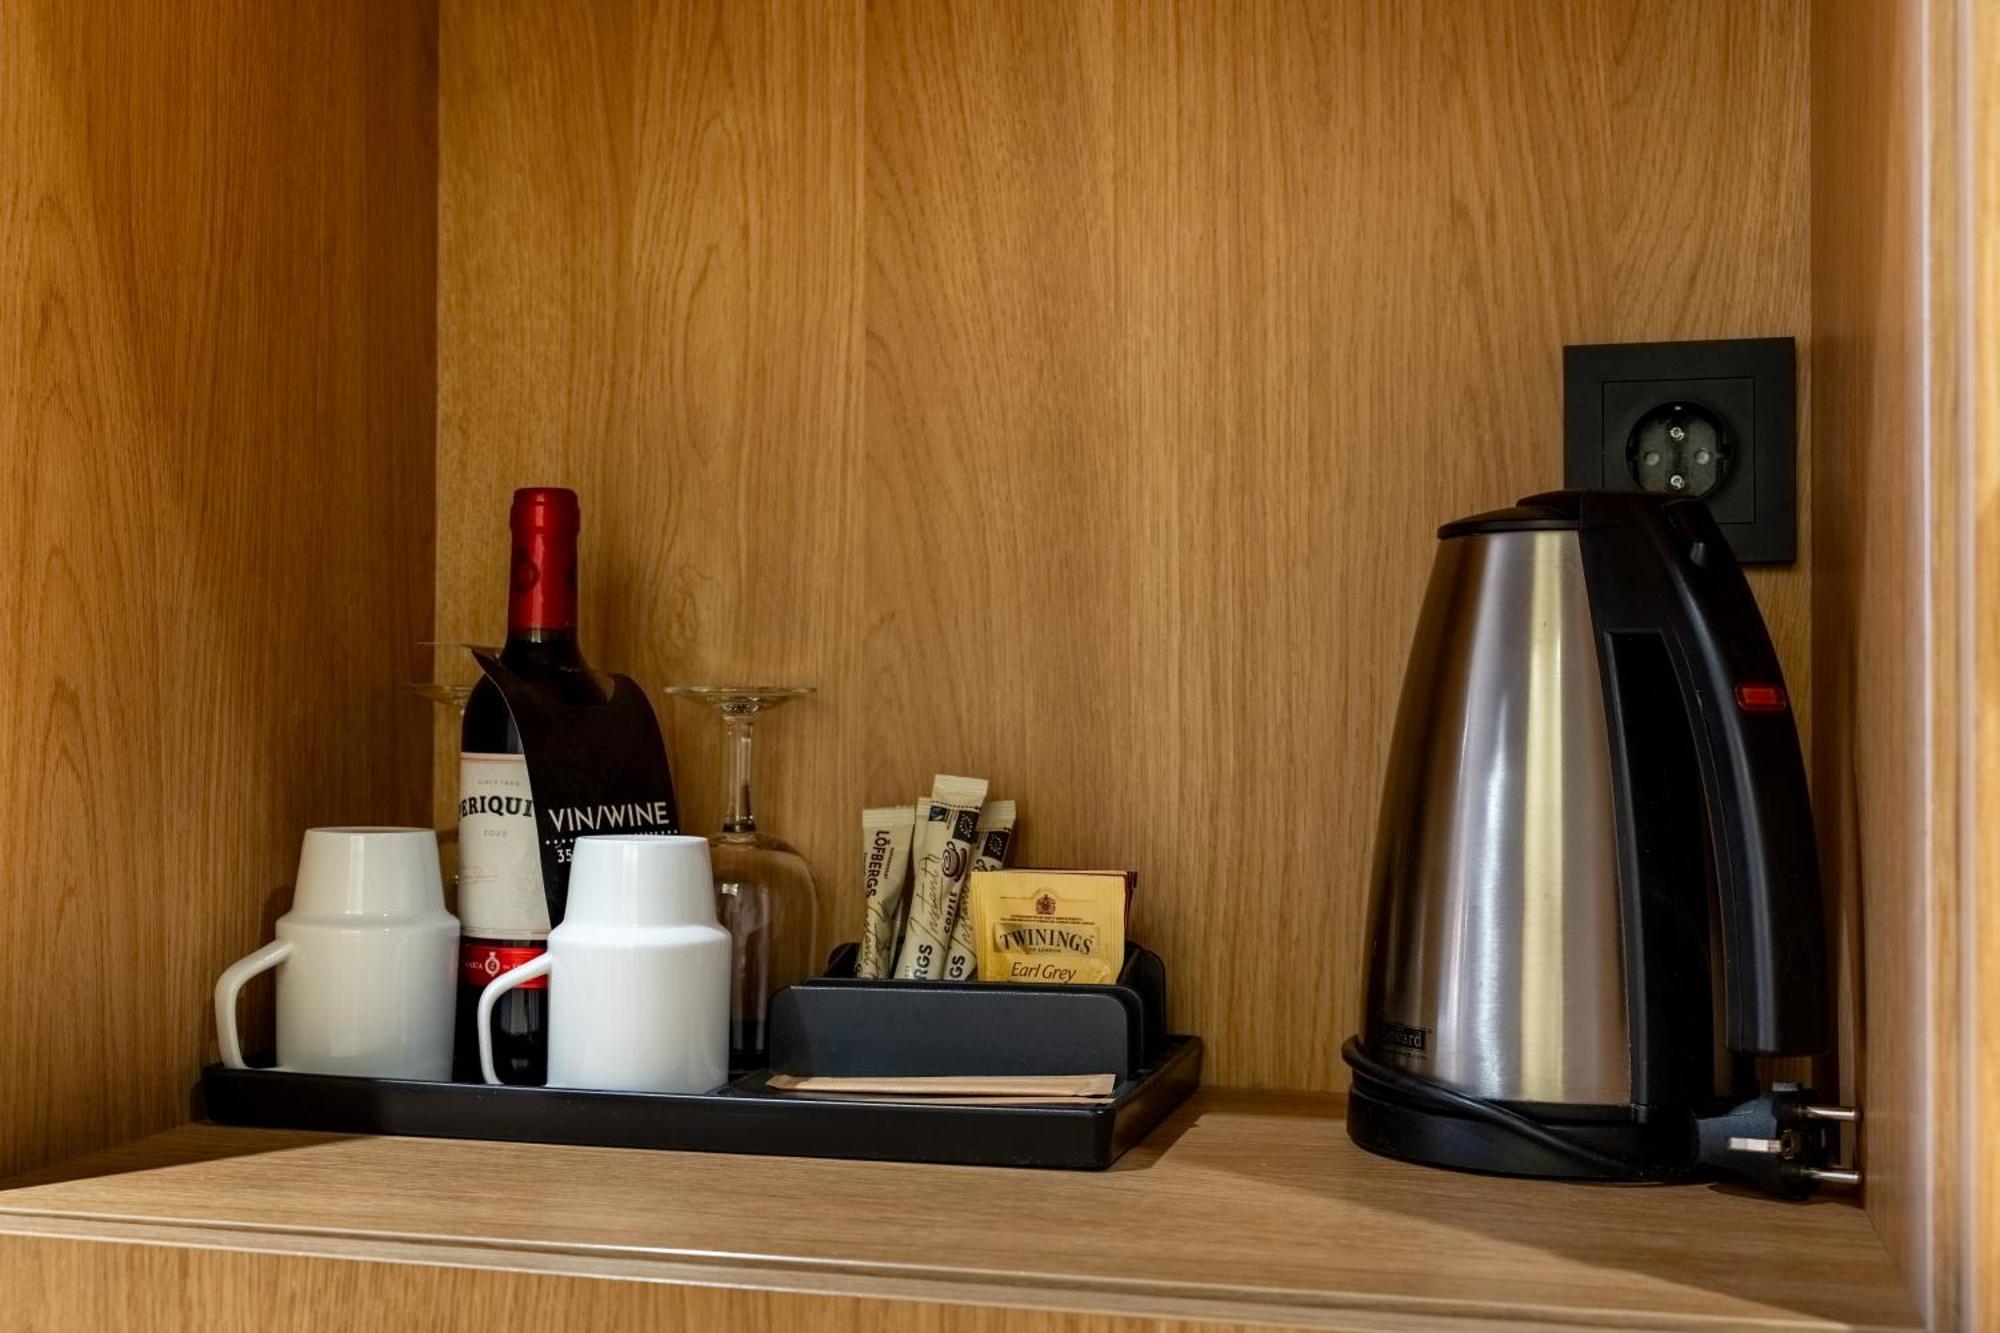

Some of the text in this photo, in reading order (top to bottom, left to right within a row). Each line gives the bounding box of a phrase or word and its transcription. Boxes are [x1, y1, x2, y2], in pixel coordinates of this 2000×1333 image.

[459, 795, 533, 820] ERIQUI
[548, 801, 670, 833] VIN/WINE
[865, 829, 890, 898] LÖFBERGS
[1000, 928, 1093, 955] TWININGS
[1011, 961, 1077, 984] Earl Grey
